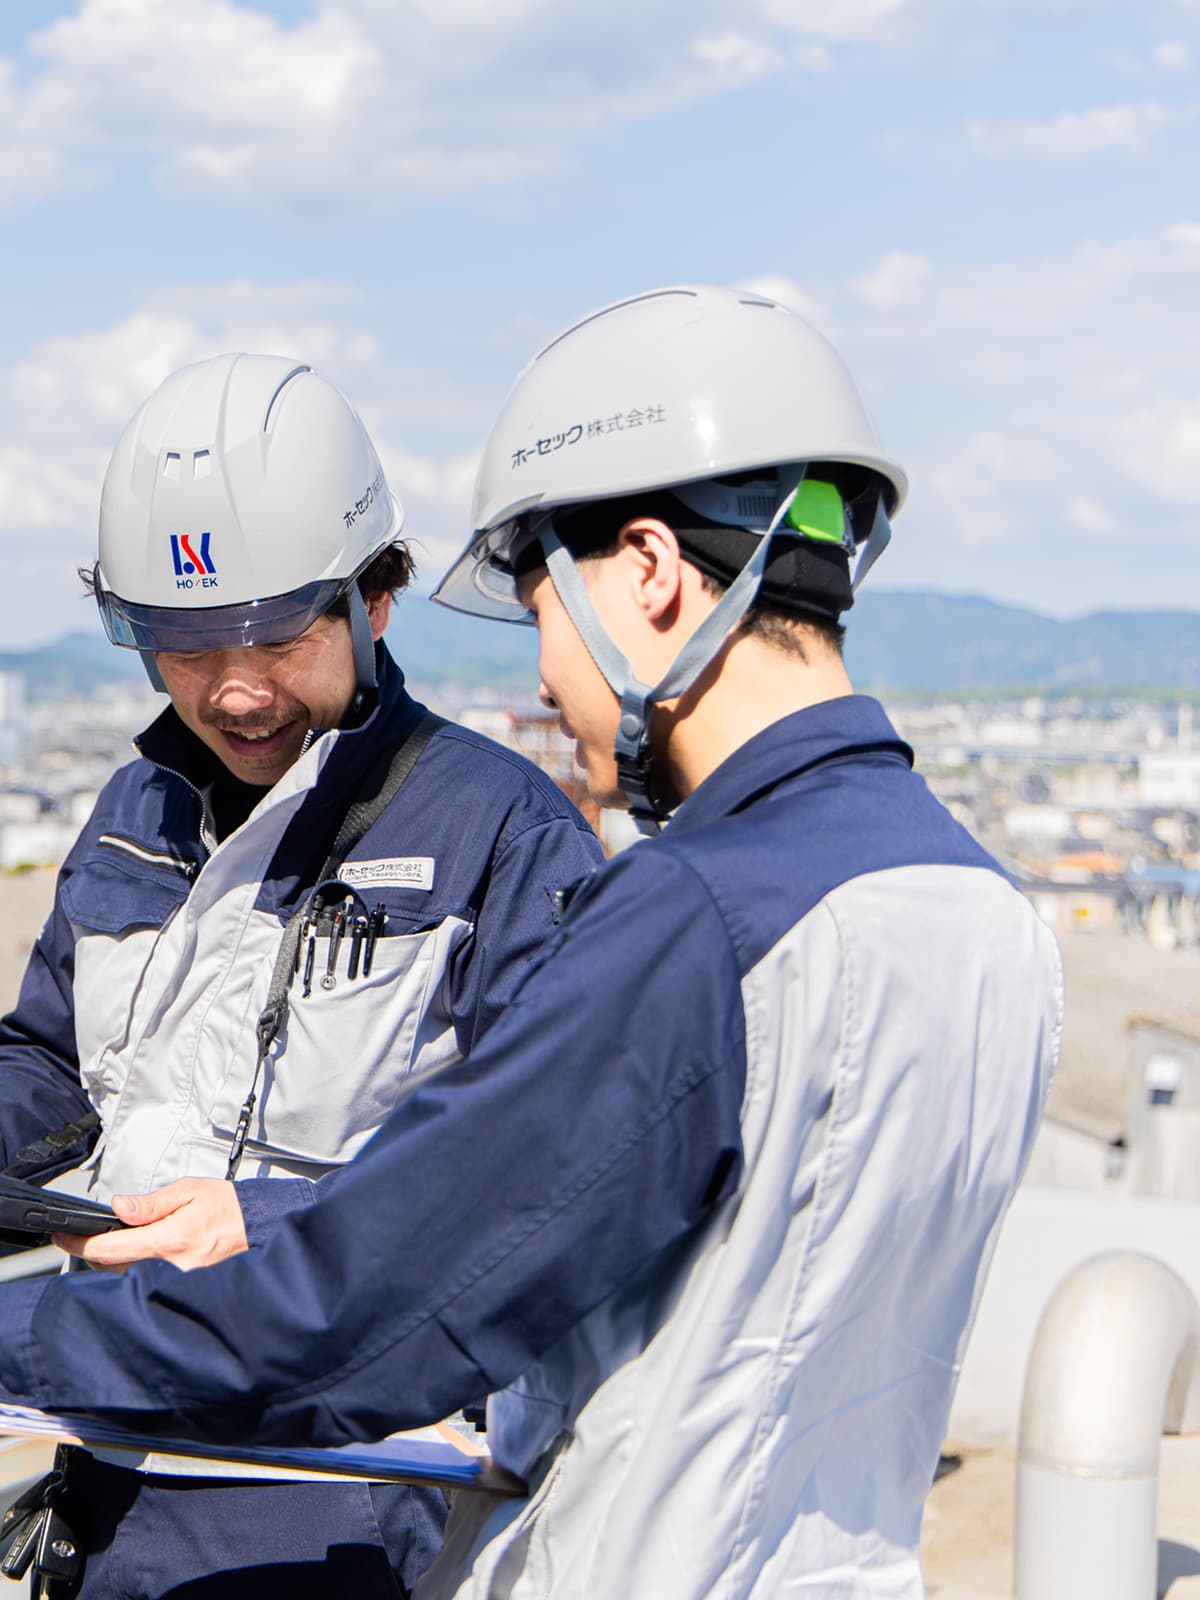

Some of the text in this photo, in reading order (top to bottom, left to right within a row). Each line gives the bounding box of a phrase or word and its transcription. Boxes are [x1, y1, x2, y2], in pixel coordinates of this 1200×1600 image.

[511, 403, 667, 470] ホーセック株式会社
[343, 471, 384, 528] ホーセック
